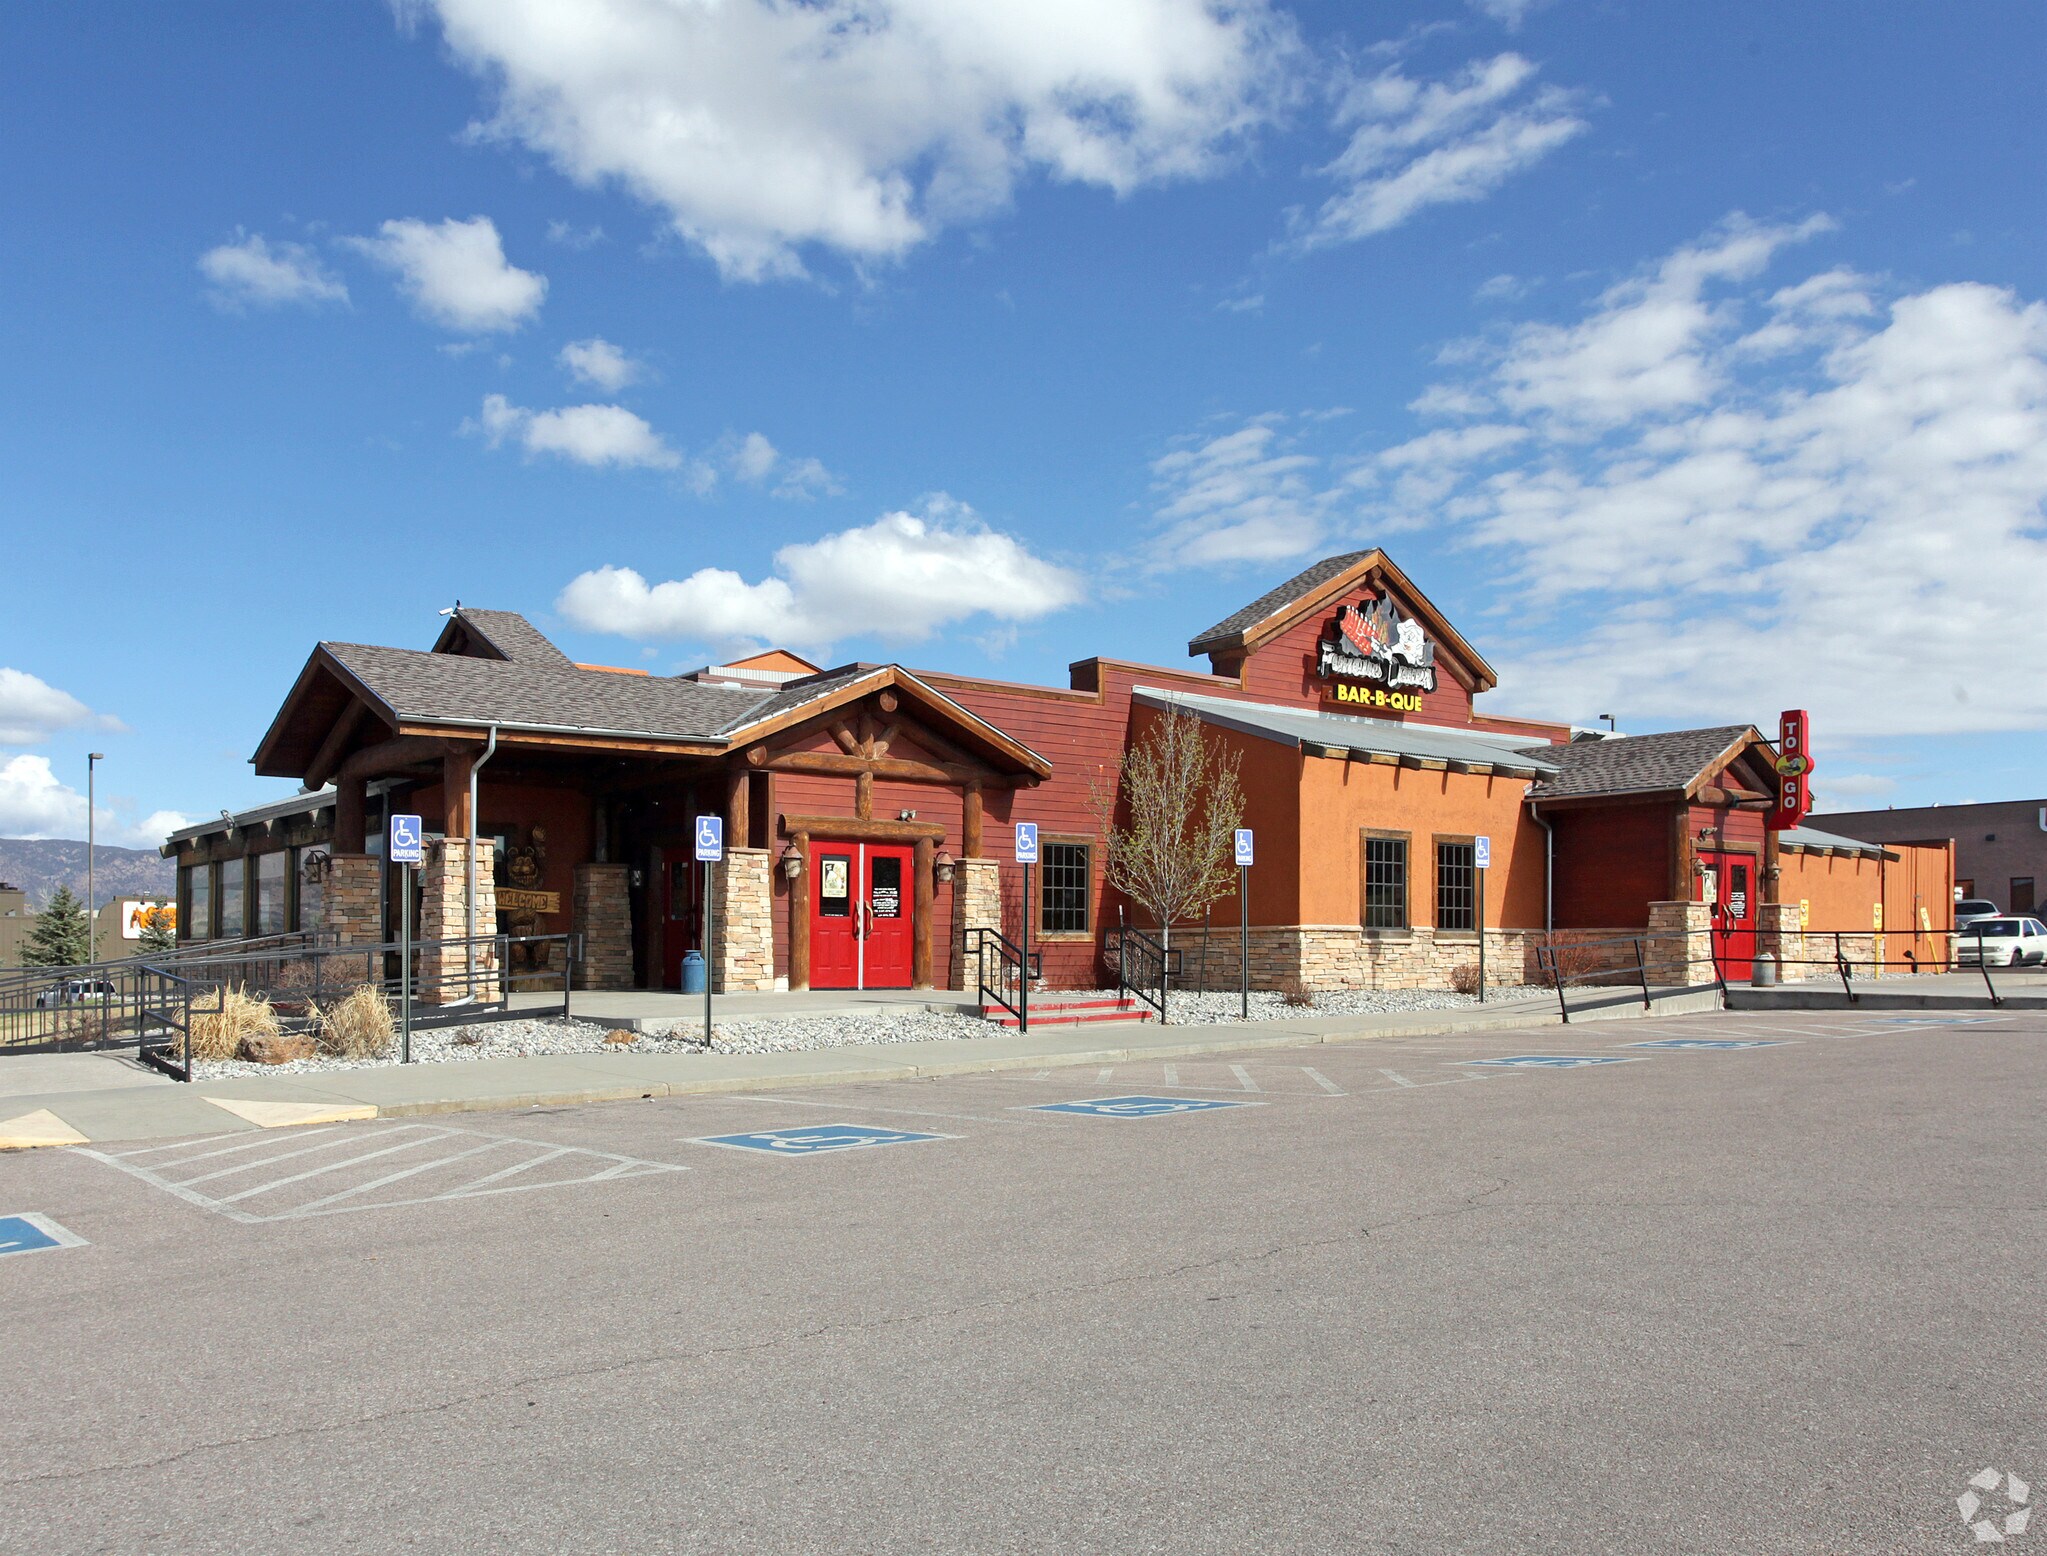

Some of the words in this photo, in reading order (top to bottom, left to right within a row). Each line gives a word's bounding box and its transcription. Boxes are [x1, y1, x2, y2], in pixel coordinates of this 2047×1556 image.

[1337, 684, 1422, 711] BAR-B-QUE
[1785, 722, 1797, 748] TO
[1784, 782, 1797, 808] GO
[394, 848, 419, 858] PARKING
[698, 848, 720, 857] PARKING
[498, 891, 547, 909] WELCOME
